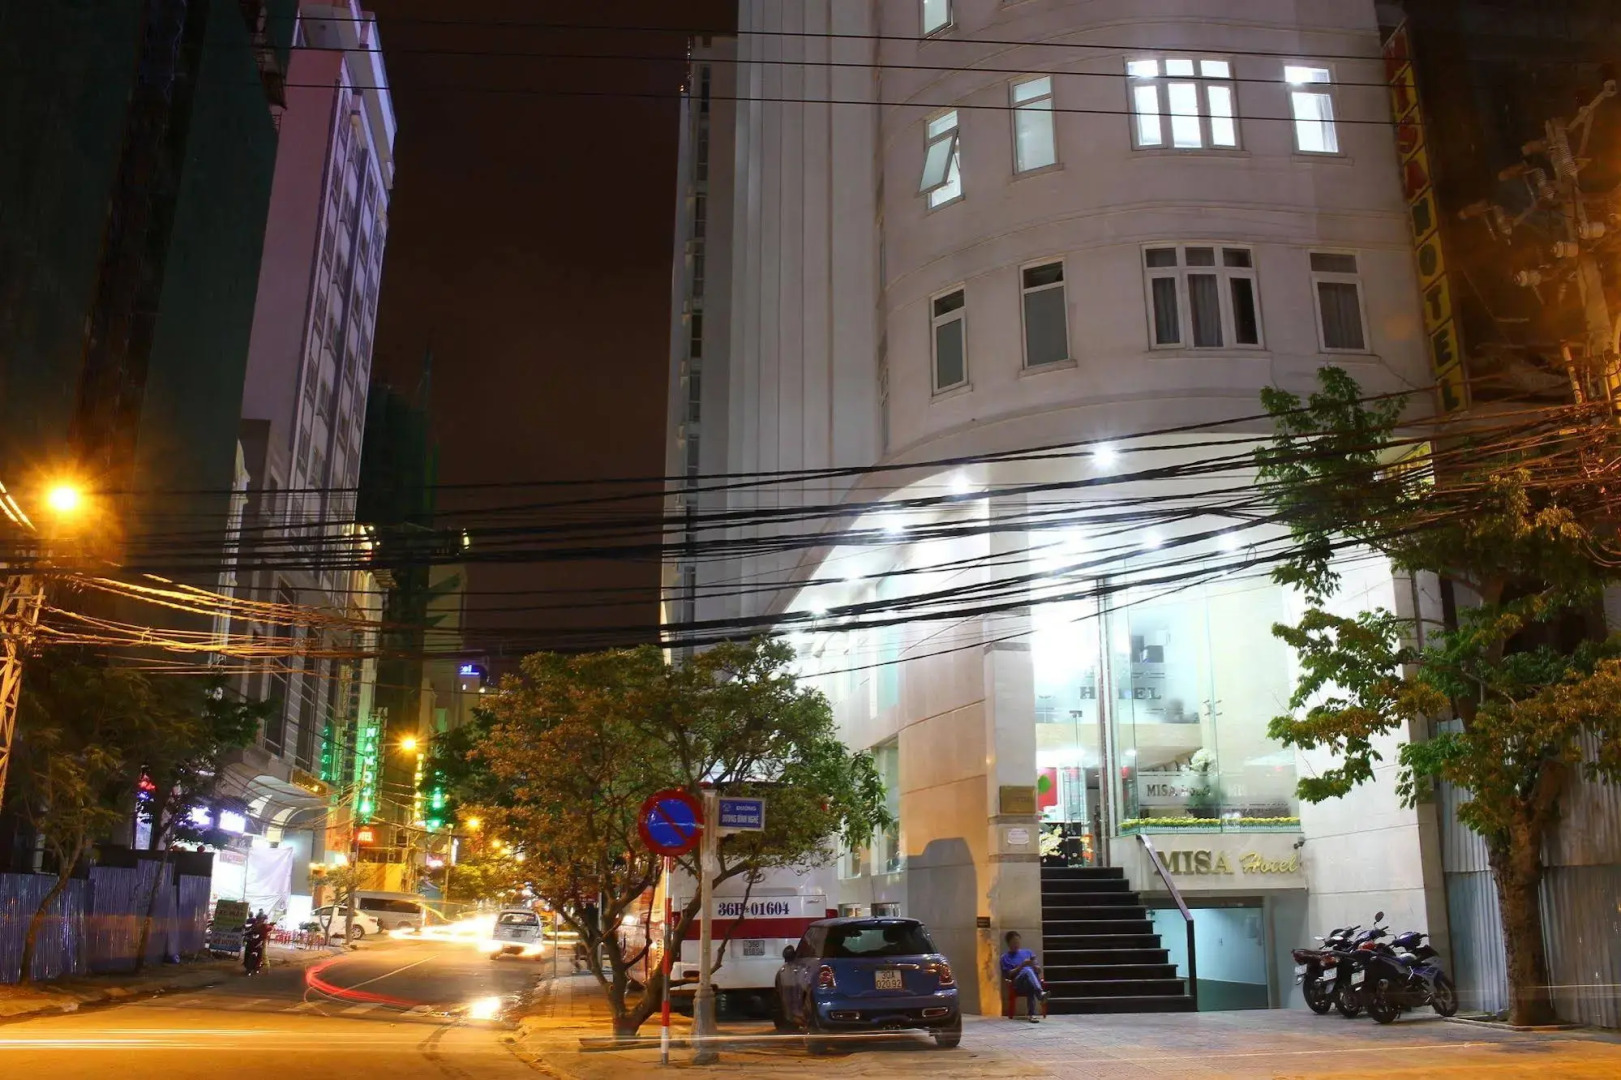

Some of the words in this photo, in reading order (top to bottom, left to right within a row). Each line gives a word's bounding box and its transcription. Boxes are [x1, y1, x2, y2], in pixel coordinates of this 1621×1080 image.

[1411, 197, 1459, 412] HOTEL
[1080, 686, 1162, 700] HEL
[1154, 850, 1235, 876] MISA
[1239, 851, 1298, 874] Hotel
